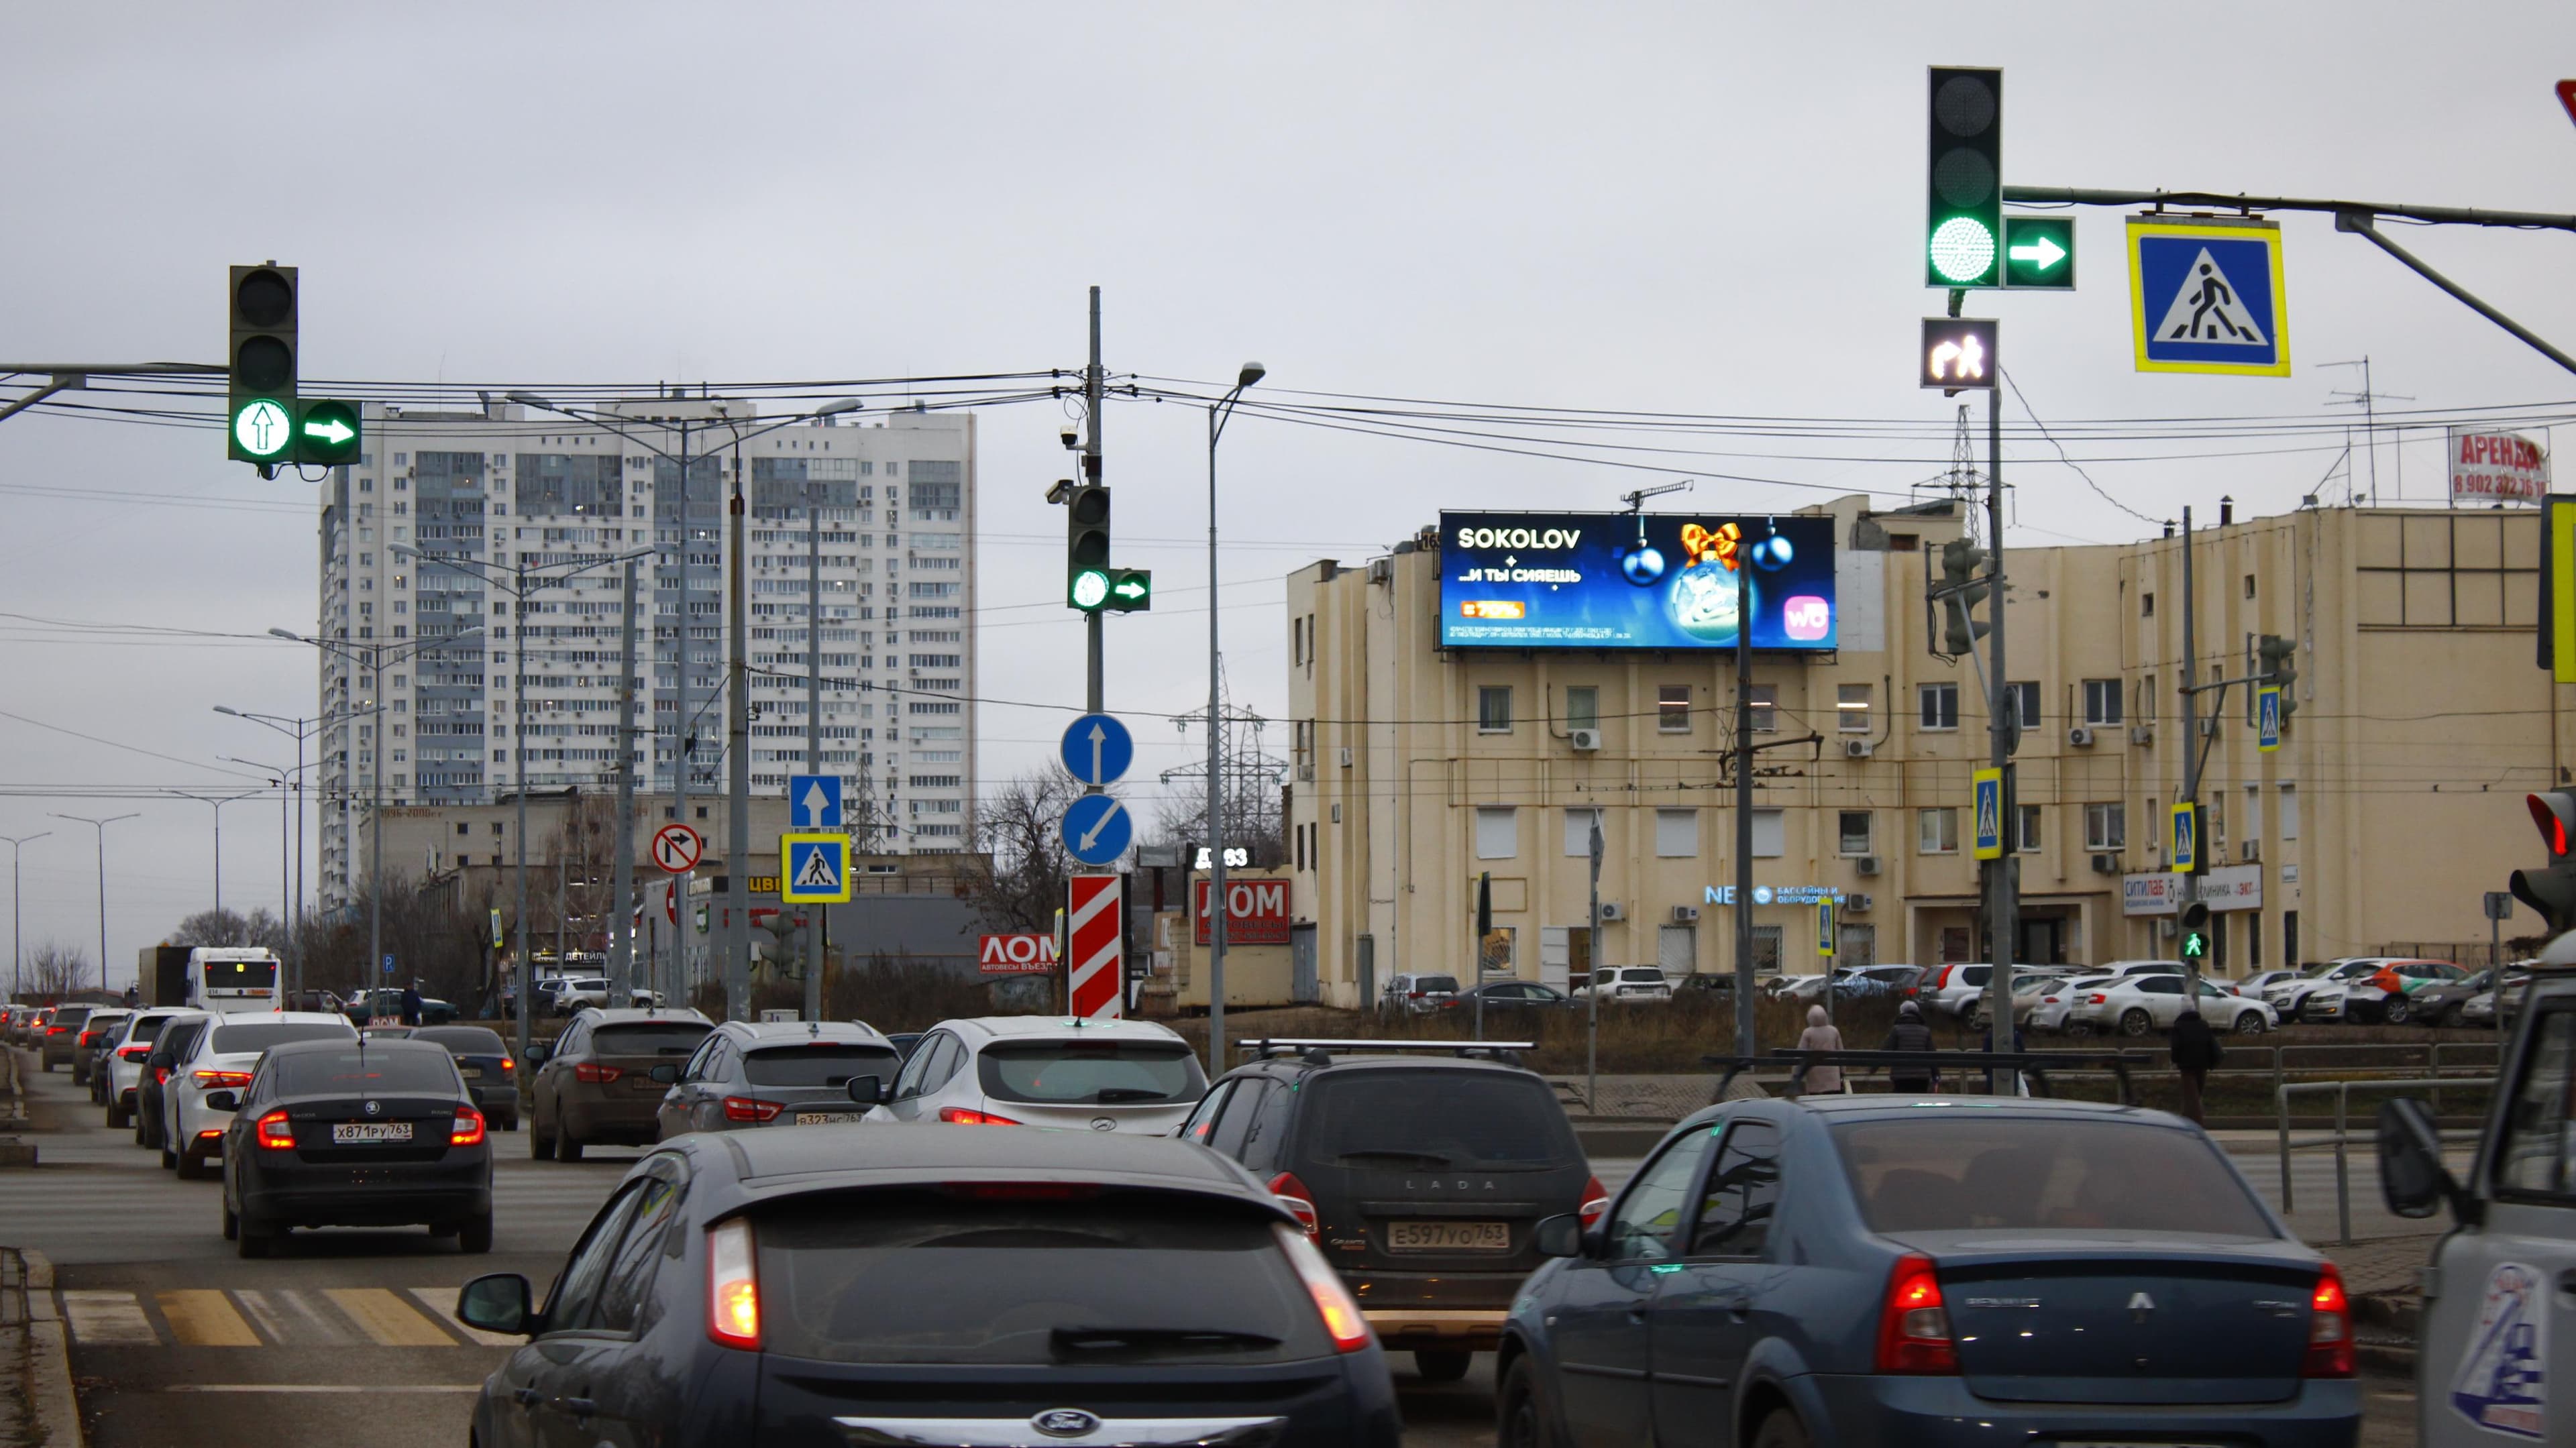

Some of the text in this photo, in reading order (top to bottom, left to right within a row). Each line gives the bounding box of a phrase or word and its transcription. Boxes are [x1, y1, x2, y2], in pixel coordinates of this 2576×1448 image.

[2461, 435, 2541, 472] АРЕНДА
[2455, 475, 2463, 493] 8
[2467, 474, 2492, 493] 902
[1458, 528, 1580, 549] SOKOLOV
[1485, 569, 1509, 582] ТЫ
[1511, 569, 1582, 583] СИЯЕШЬ
[2200, 884, 2231, 899] КЛИНИКА
[390, 1123, 410, 1135] 763
[1406, 1180, 1495, 1190] LADA
[1476, 1225, 1504, 1240] 763
